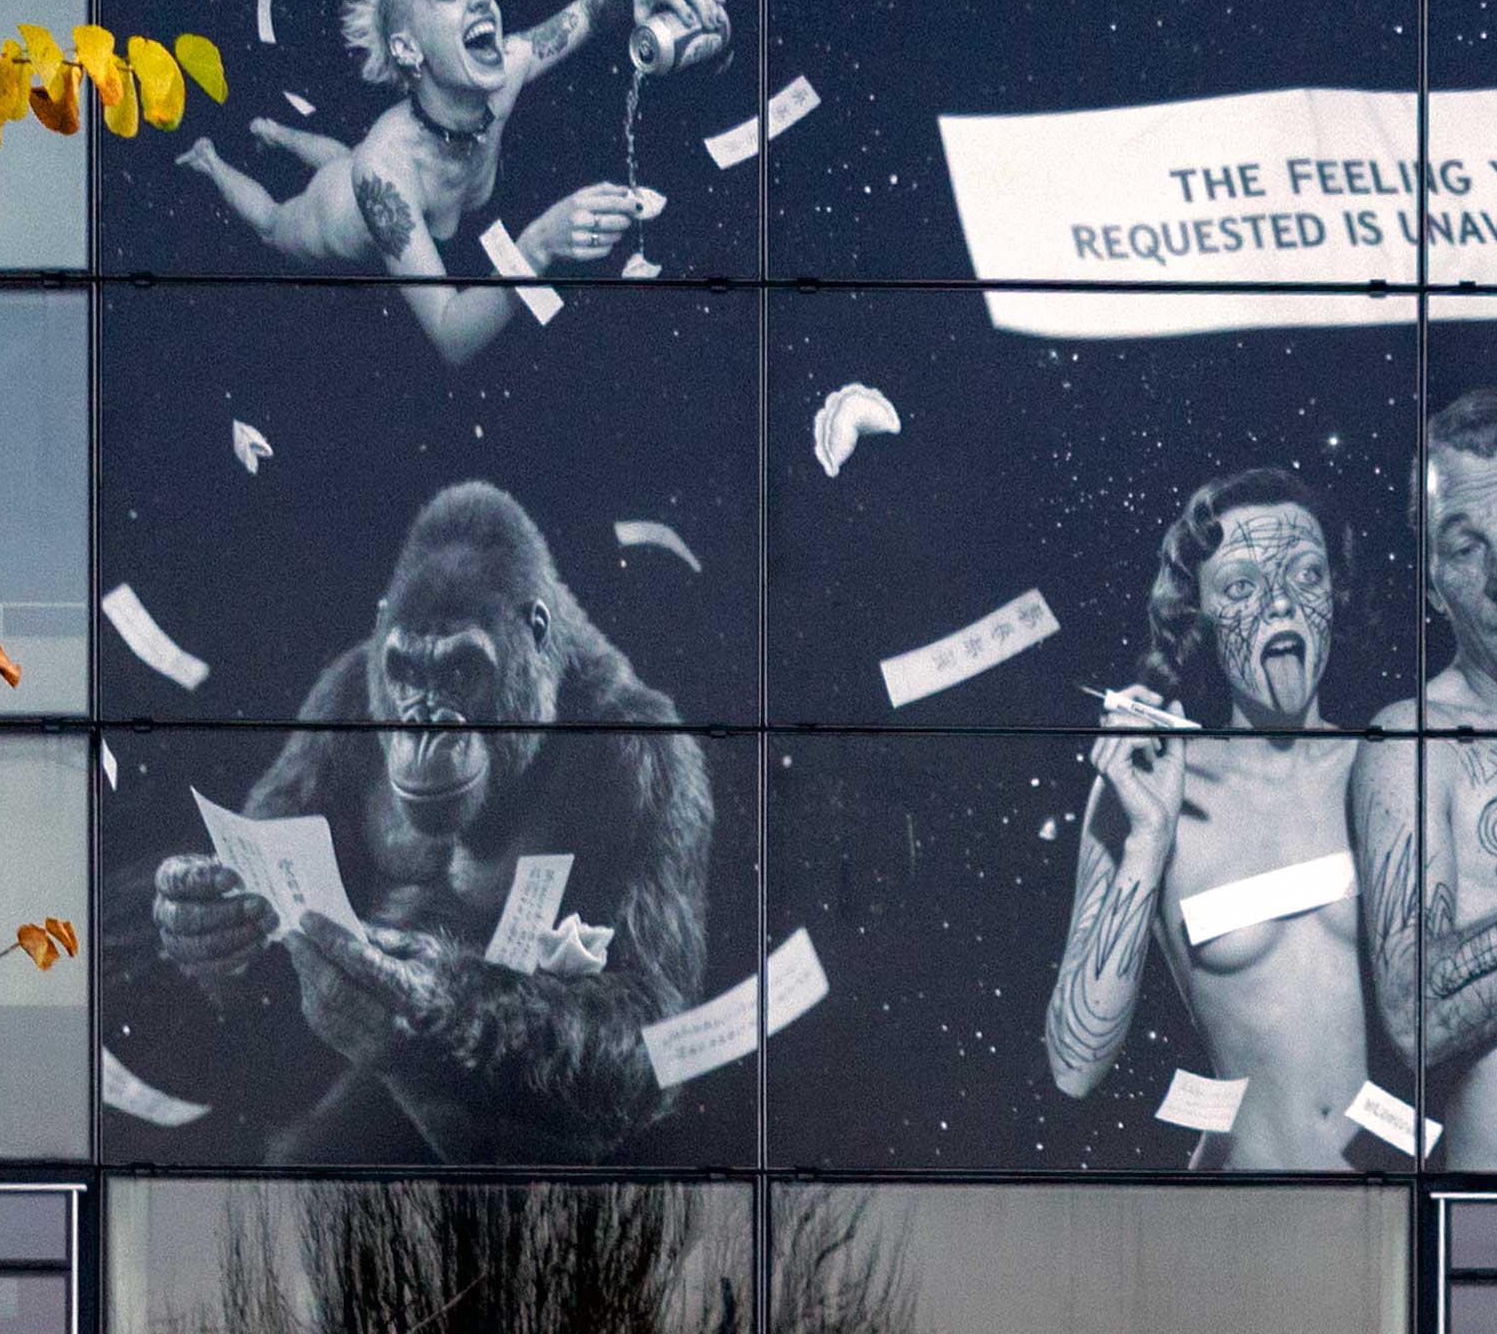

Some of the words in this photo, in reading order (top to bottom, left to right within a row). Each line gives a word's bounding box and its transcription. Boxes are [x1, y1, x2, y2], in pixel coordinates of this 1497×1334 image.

[1170, 163, 1266, 204] THE
[1287, 157, 1472, 200] FEELING
[1071, 211, 1326, 263] REQUESTED
[1345, 210, 1384, 246] IS
